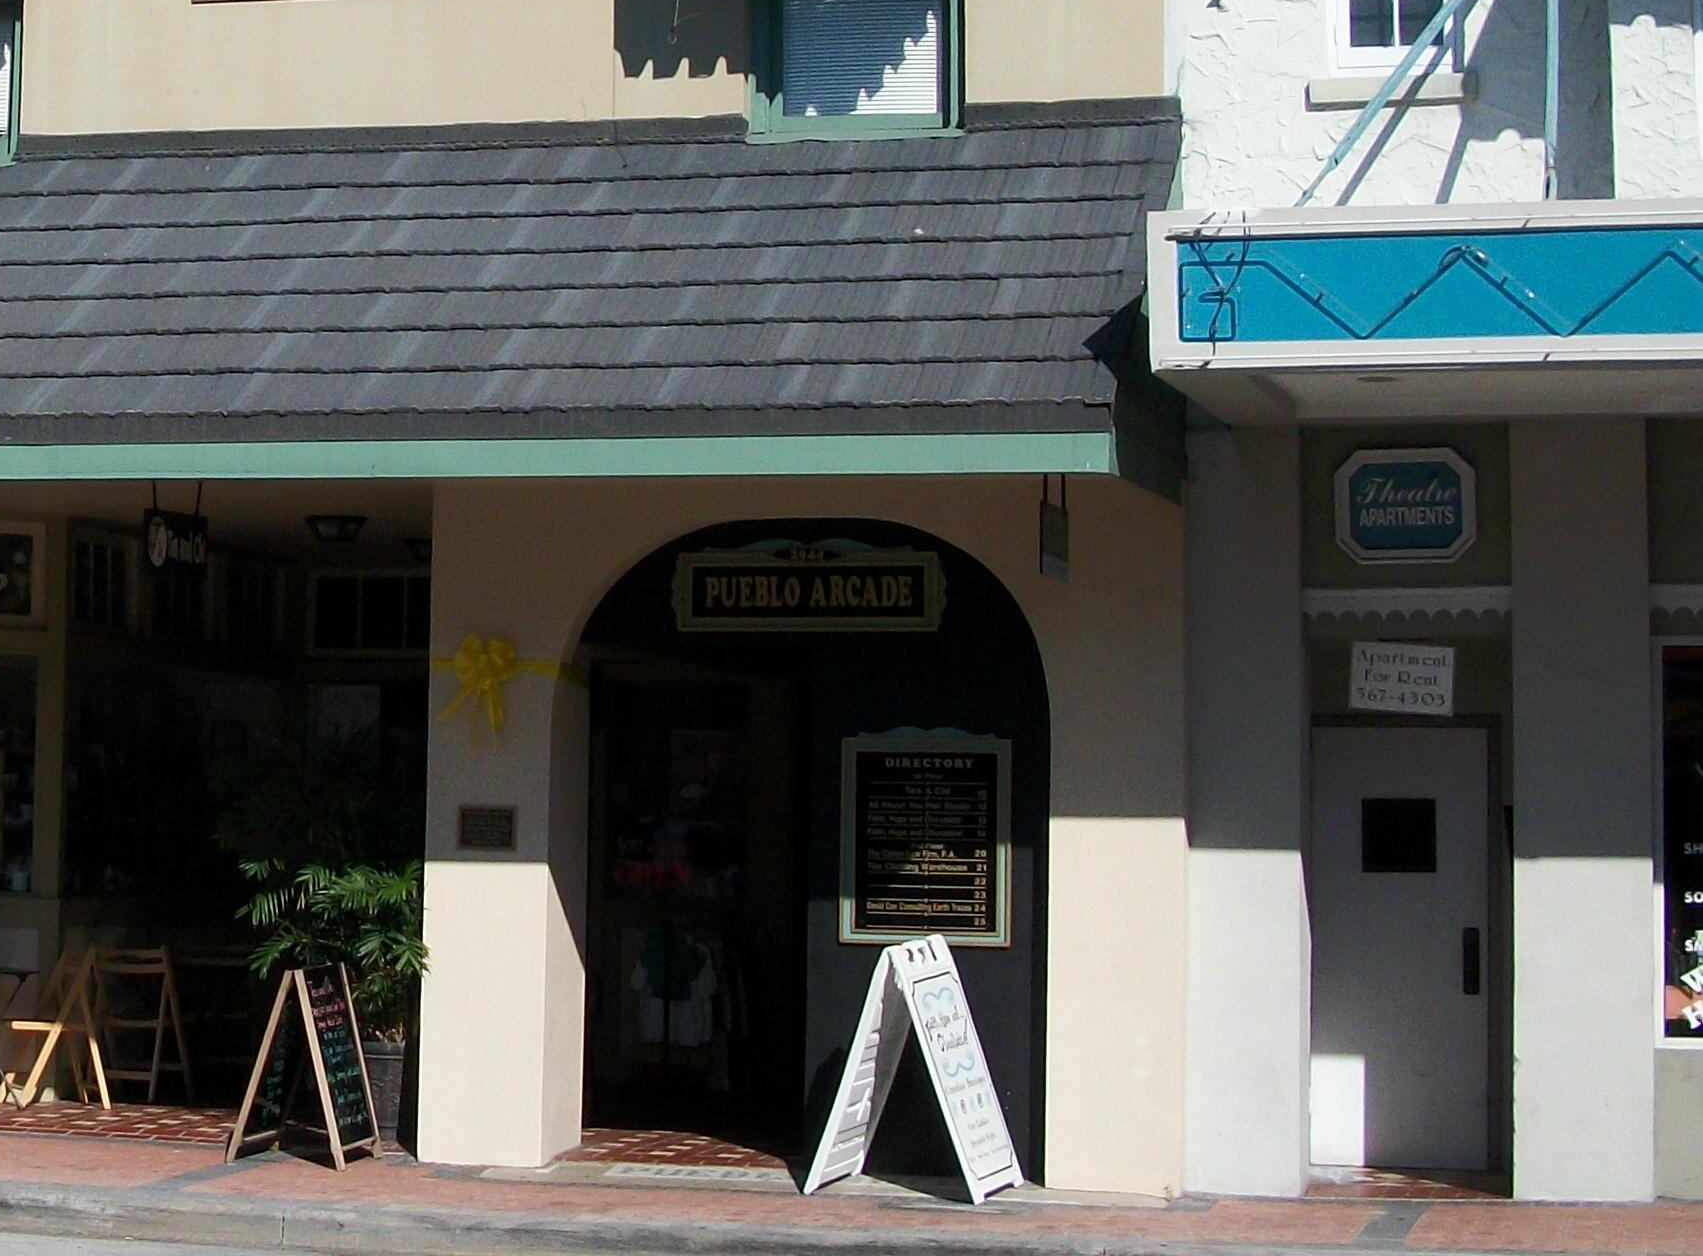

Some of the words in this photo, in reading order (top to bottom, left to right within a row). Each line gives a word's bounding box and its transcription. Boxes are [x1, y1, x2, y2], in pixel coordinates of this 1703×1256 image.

[1356, 477, 1456, 504] Theatre
[1359, 506, 1455, 527] APARTMENTS
[705, 575, 800, 608] PUEBLO
[809, 575, 913, 608] ARCADE
[1358, 647, 1448, 668] Apartment
[1364, 668, 1391, 684] For
[1397, 669, 1439, 686] Rent
[885, 758, 975, 769] DIRECTORY
[975, 849, 987, 857] 20
